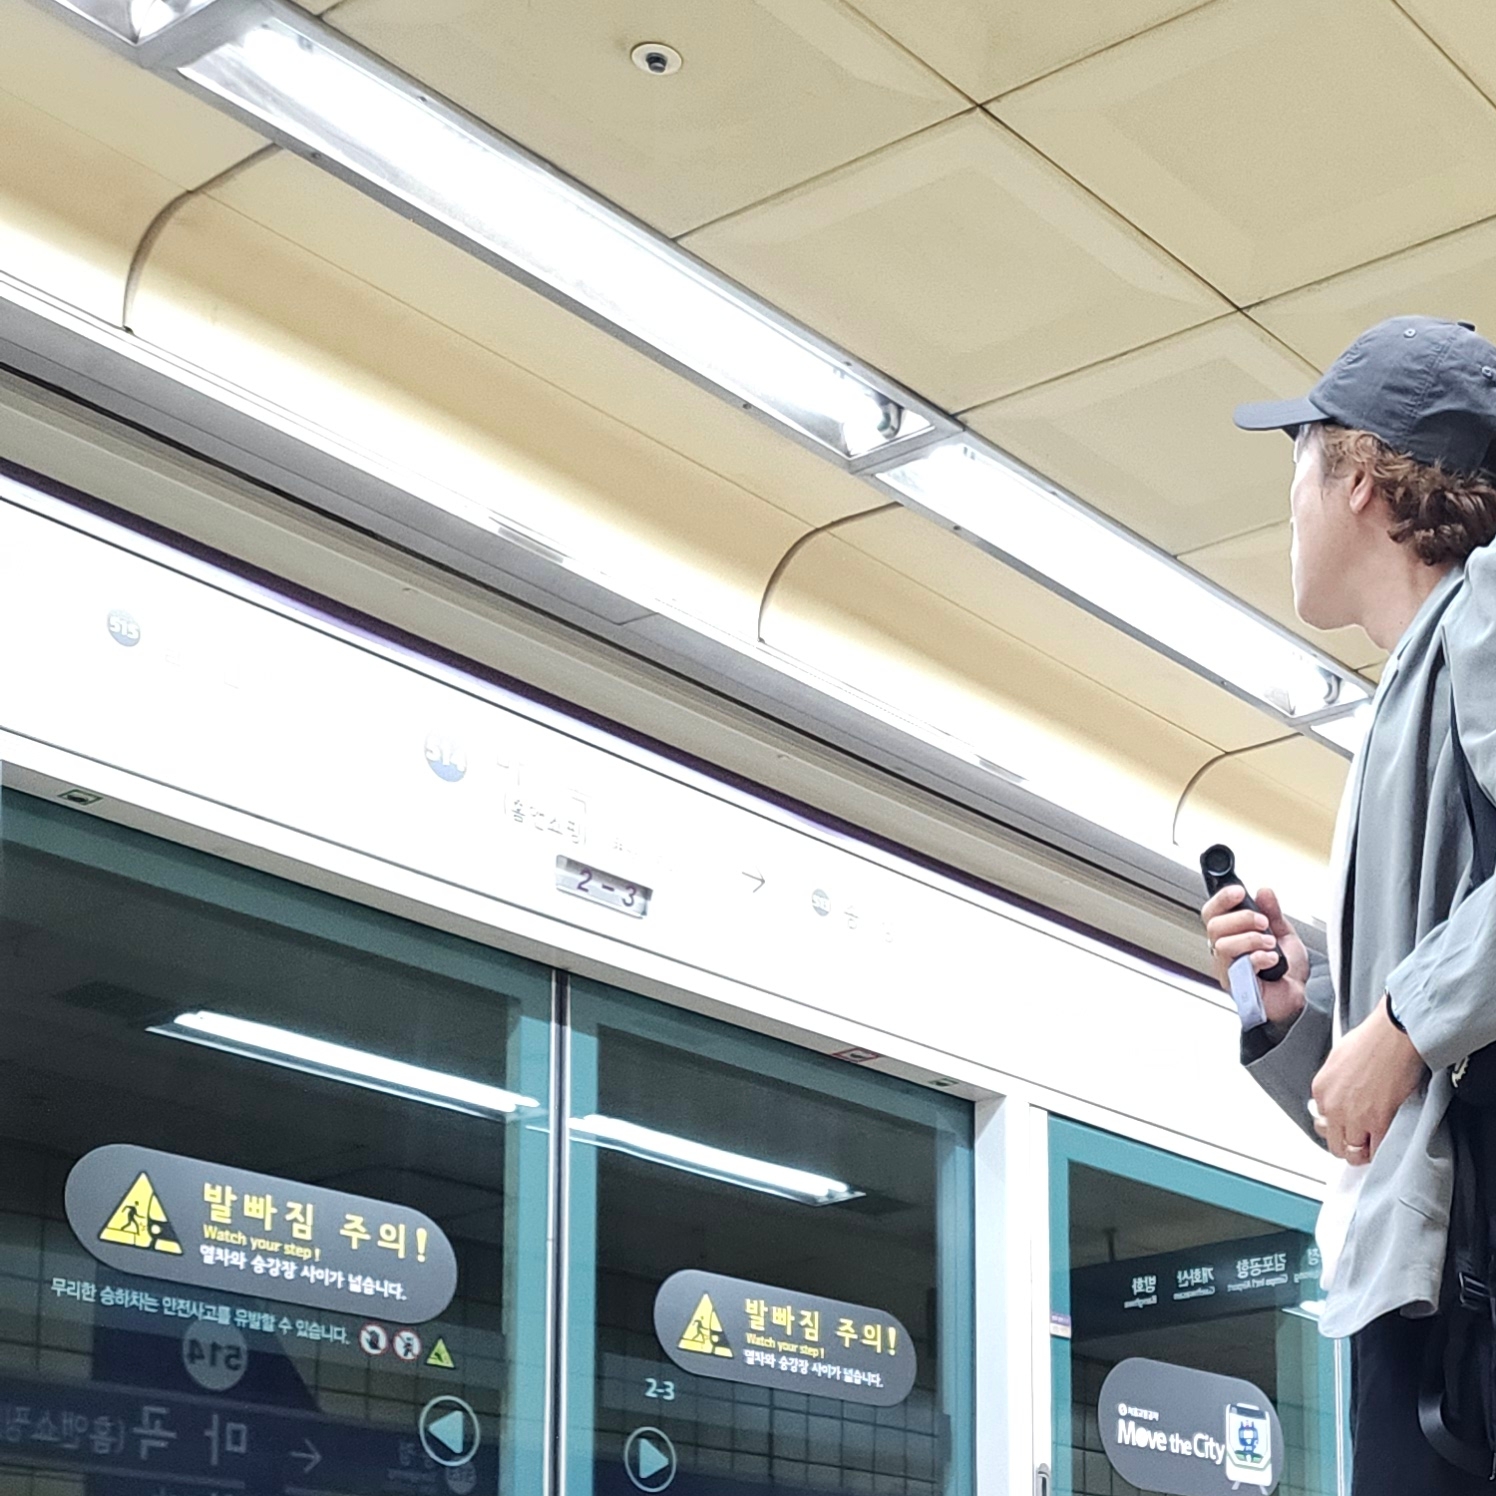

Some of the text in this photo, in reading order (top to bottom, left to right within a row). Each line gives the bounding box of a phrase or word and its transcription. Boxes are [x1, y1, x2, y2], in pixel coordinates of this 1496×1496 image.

[203, 1182, 428, 1263] 발빠짐 주의!
[203, 1224, 247, 1247] Watch
[250, 1236, 282, 1253] your
[200, 1244, 248, 1270] 열차와
[250, 1255, 297, 1281] 승강장
[300, 1264, 346, 1290] 사이가
[51, 1277, 351, 1345] 무리한 승하차는 안전사고를 유발할 수 있습니다.
[745, 1298, 897, 1357] 발빠짐 주의!
[743, 1349, 777, 1369] 열차와
[778, 1357, 809, 1376] 승강장
[811, 1363, 841, 1382] 사이가
[745, 1332, 776, 1348] Watch
[778, 1339, 799, 1353] your
[644, 1378, 675, 1400] 2-3
[1117, 1418, 1226, 1466] Move the City
